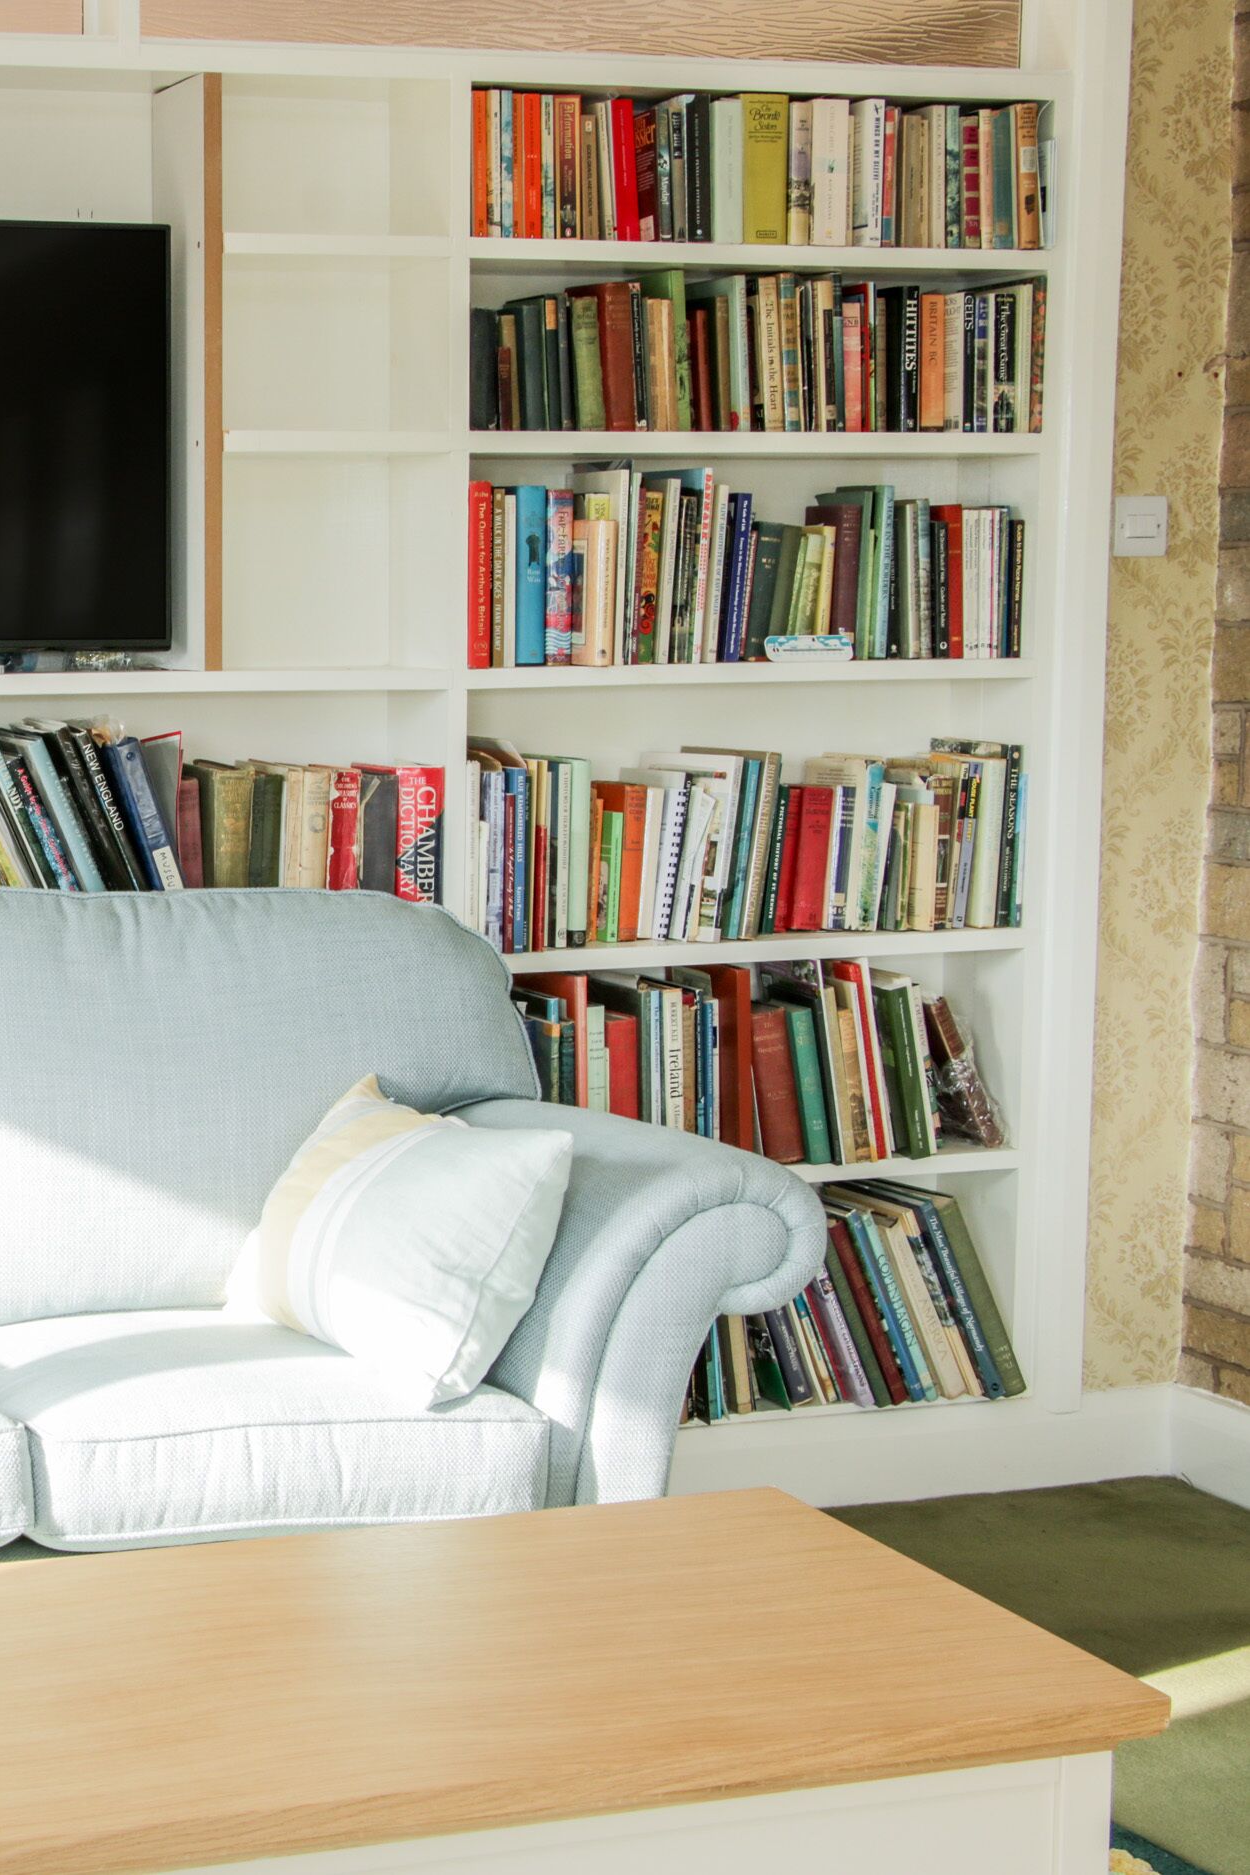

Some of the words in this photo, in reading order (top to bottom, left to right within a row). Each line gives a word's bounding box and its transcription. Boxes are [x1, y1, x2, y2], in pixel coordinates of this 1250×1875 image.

[563, 103, 575, 160] Reformation
[661, 176, 670, 205] Mayday!
[765, 302, 774, 319] The
[964, 295, 975, 331] CELTS
[1000, 303, 1011, 324] The
[905, 299, 918, 371] HITTITES
[929, 301, 938, 346] BRITAIN
[766, 322, 776, 353] Initials
[1000, 323, 1009, 352] Great
[769, 355, 775, 366] in
[929, 351, 938, 367] BC
[999, 352, 1008, 381] Game
[769, 367, 779, 384] the
[769, 385, 778, 411] Heart
[478, 502, 487, 519] The
[701, 474, 713, 541] DANMARK
[719, 503, 727, 520] FLINT
[885, 505, 893, 529] HACK
[478, 521, 487, 550] Quest
[494, 513, 502, 536] WALK
[885, 530, 892, 541] IN
[494, 536, 502, 545] IN
[494, 546, 502, 559] THE
[716, 522, 725, 567] ARCHITECTURE
[883, 543, 891, 560] THE
[478, 551, 487, 564] for
[494, 560, 502, 580] DARK
[715, 568, 723, 576] OF
[882, 563, 890, 600] BORDERS
[478, 565, 487, 604] Arthur's
[494, 580, 502, 599] AGES
[714, 578, 722, 593] EAST
[494, 604, 502, 624] FRANK
[712, 593, 721, 616] ANGLIA
[478, 605, 487, 637] Britain
[82, 743, 99, 772] NEW
[95, 773, 125, 832] ENGLAND
[409, 775, 427, 785] THE
[764, 764, 777, 802] RIDDLES
[970, 777, 978, 798] HOUSE
[1010, 767, 1019, 789] THE
[763, 803, 771, 814] IN
[867, 785, 877, 819] Cornwall
[967, 798, 976, 818] PLANT
[760, 815, 769, 833] THE
[777, 806, 785, 841] PICTORIAL
[1006, 791, 1017, 840] SEASONS
[399, 787, 416, 896] DICTIONARY
[755, 833, 767, 868] BRITISH
[773, 842, 782, 871] HISTORY
[773, 872, 779, 880] OF
[747, 868, 763, 922] LANDSCAPE
[768, 894, 776, 919] GENNYS
[670, 1001, 679, 1028] ROBERT
[671, 1029, 679, 1043] KEE
[669, 1048, 683, 1099] Ireland
[930, 1215, 941, 1231] The
[933, 1231, 946, 1249] Most
[939, 1248, 956, 1281] Beautiful
[876, 1254, 918, 1349] COPENHAGEN
[951, 1279, 967, 1308] Villages
[961, 1306, 972, 1317] of
[965, 1316, 985, 1354] Normandy
